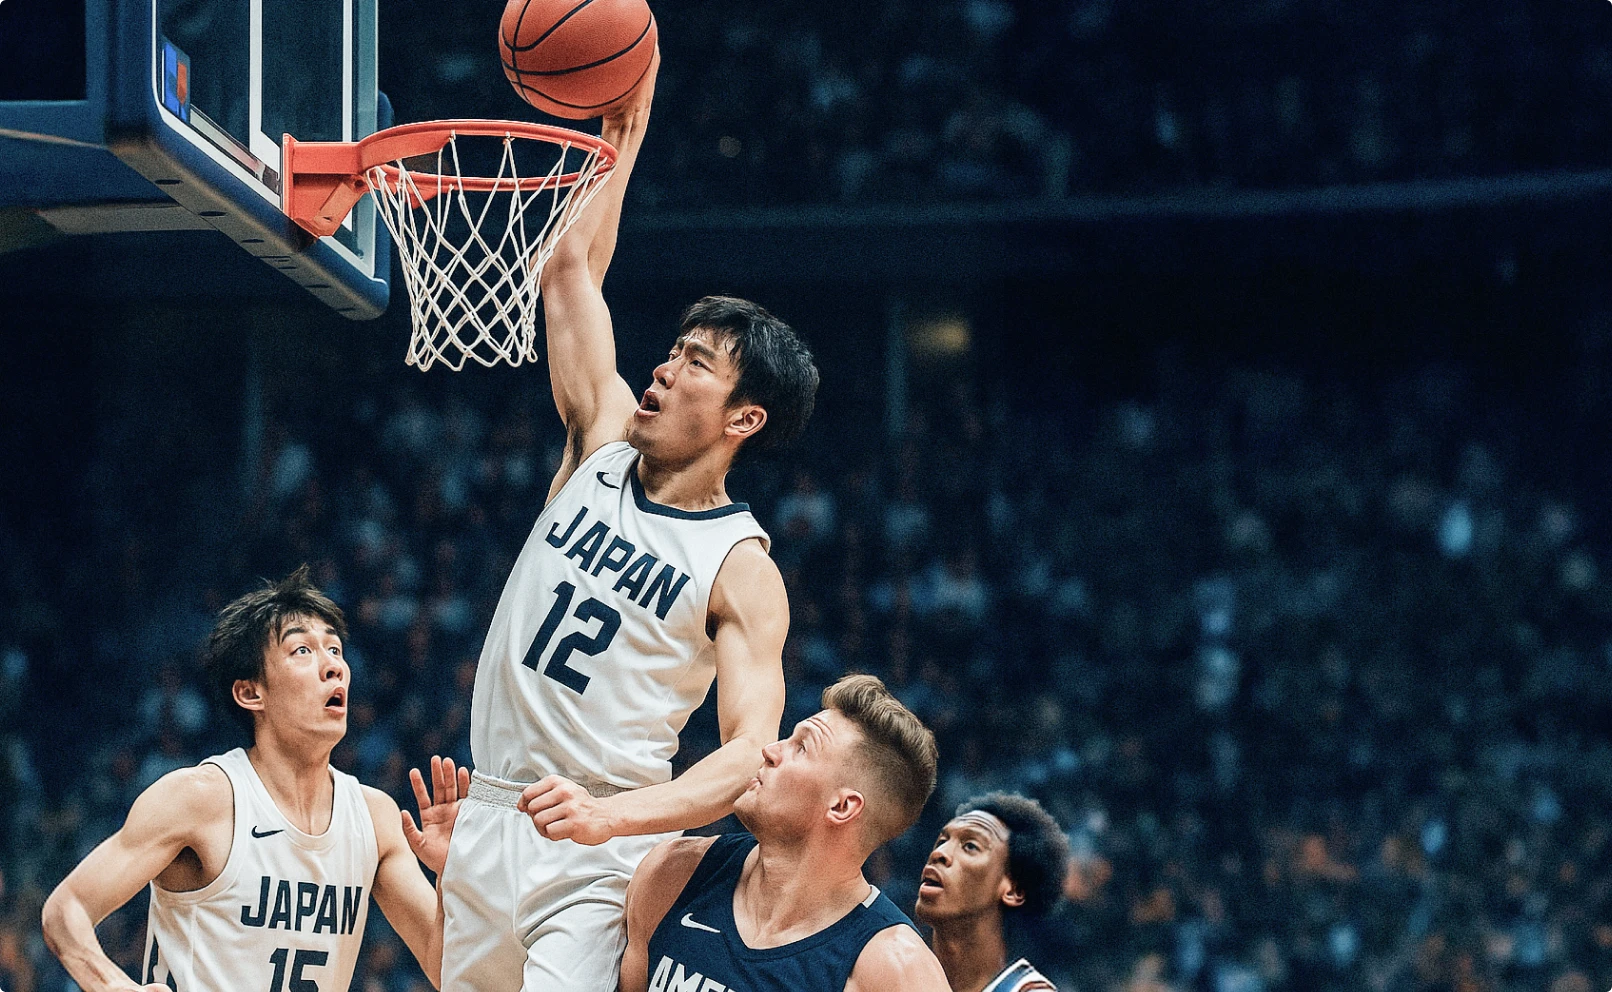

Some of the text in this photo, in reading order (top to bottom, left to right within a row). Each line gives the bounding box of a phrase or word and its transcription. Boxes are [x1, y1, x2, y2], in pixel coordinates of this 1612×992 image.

[545, 506, 691, 621] JAPAN
[521, 580, 622, 695] 12
[240, 875, 363, 935] JAPAN
[269, 947, 329, 992] 15
